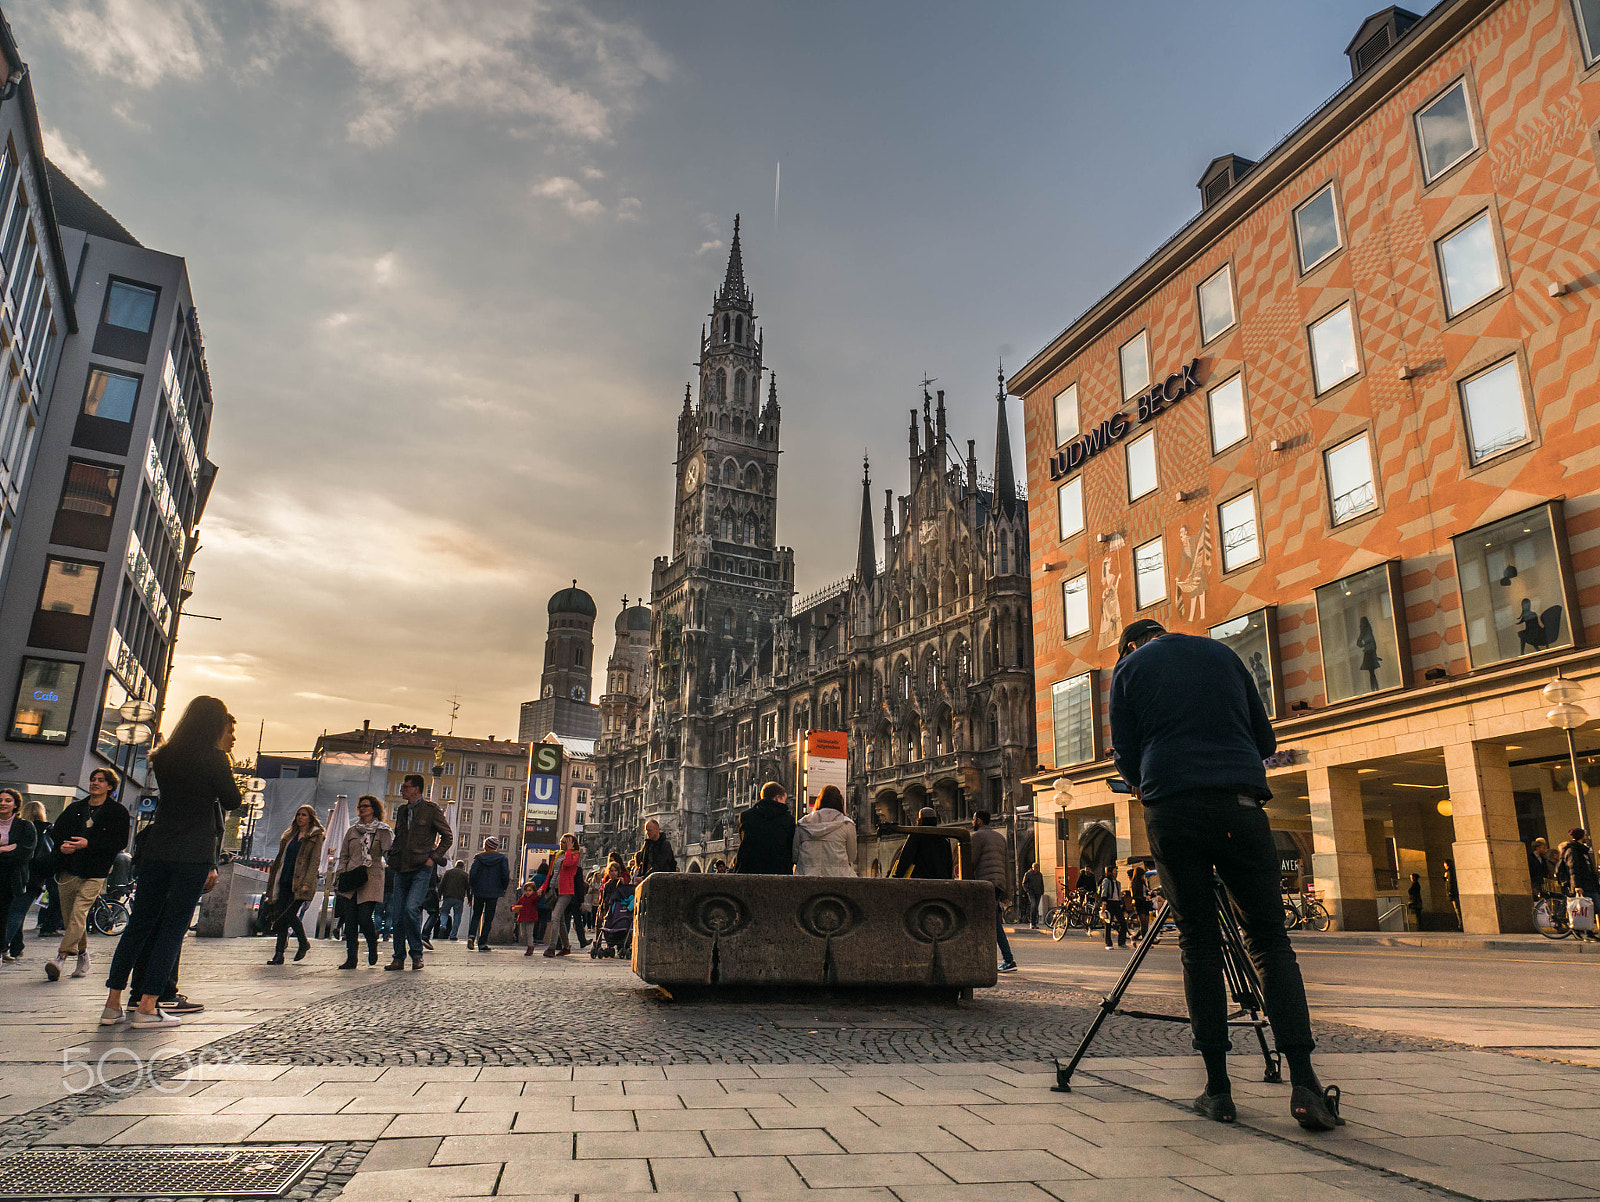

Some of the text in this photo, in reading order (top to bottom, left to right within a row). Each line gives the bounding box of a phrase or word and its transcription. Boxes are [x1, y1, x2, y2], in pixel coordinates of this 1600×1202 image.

[1049, 358, 1201, 481] LUDWIG BECK
[537, 747, 556, 770] S
[534, 777, 553, 800] U
